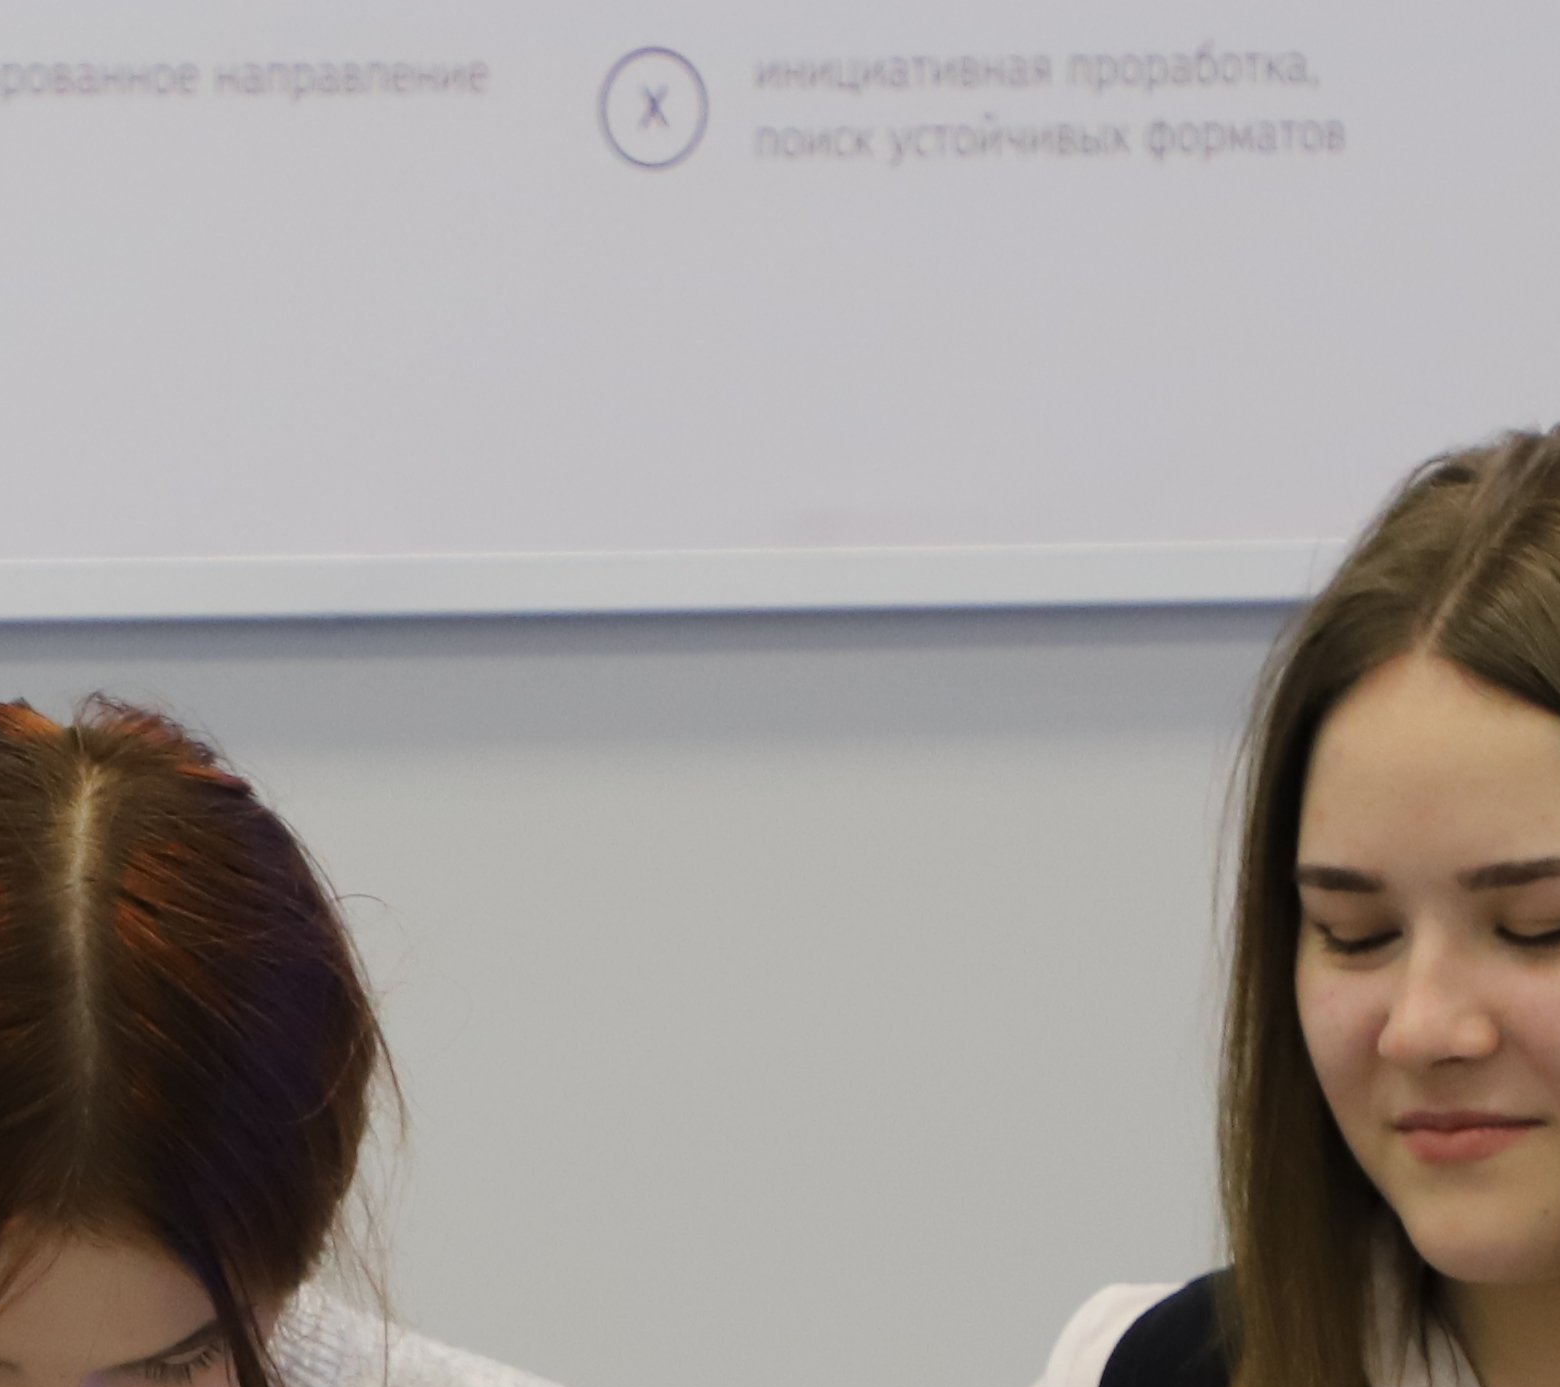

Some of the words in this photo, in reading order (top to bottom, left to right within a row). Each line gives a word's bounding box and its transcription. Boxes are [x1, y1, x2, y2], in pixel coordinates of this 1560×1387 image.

[214, 60, 491, 104] направление
[754, 53, 1053, 96] инициативная
[1068, 39, 1321, 93] проработка,
[754, 124, 875, 159] поиск
[888, 112, 1131, 167] устойчивых
[1143, 116, 1348, 166] форматов
